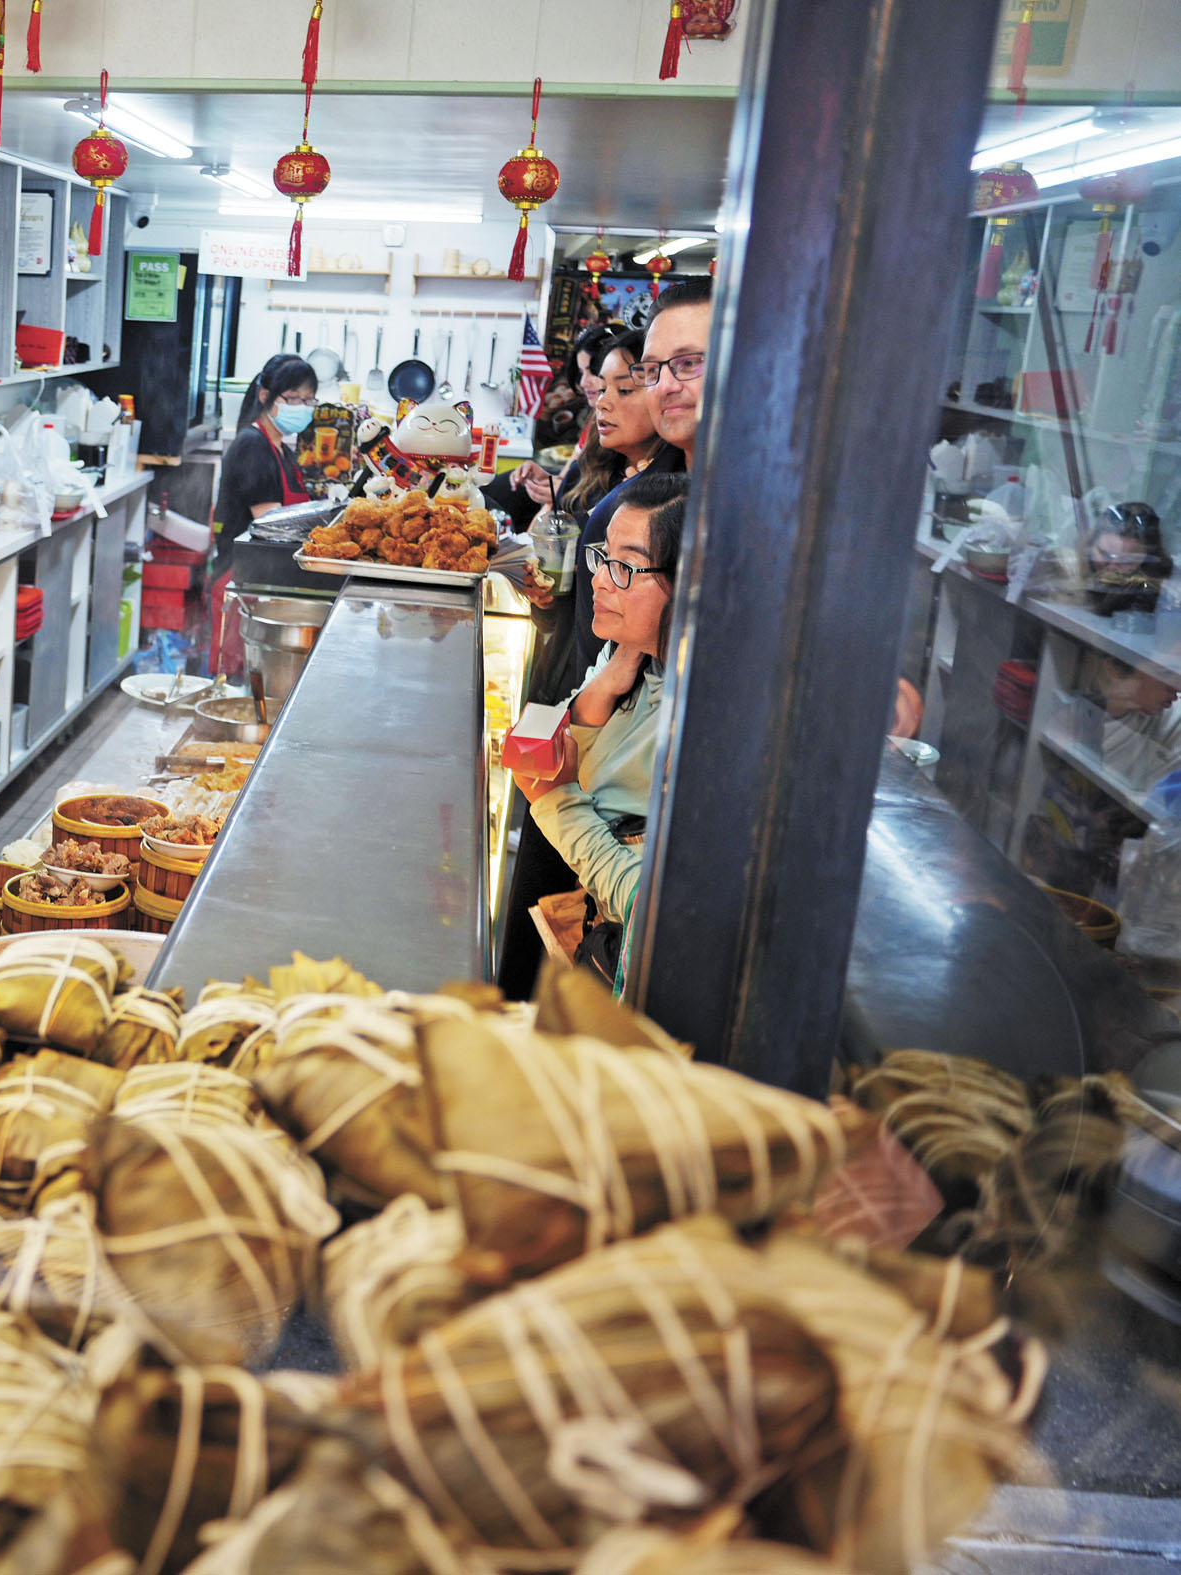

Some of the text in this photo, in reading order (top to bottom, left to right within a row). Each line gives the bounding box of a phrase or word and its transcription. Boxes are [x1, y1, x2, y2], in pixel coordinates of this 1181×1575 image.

[210, 243, 256, 257] ONLINE
[139, 261, 170, 273] PASS
[213, 256, 239, 269] PICK
[243, 260, 260, 270] UP
